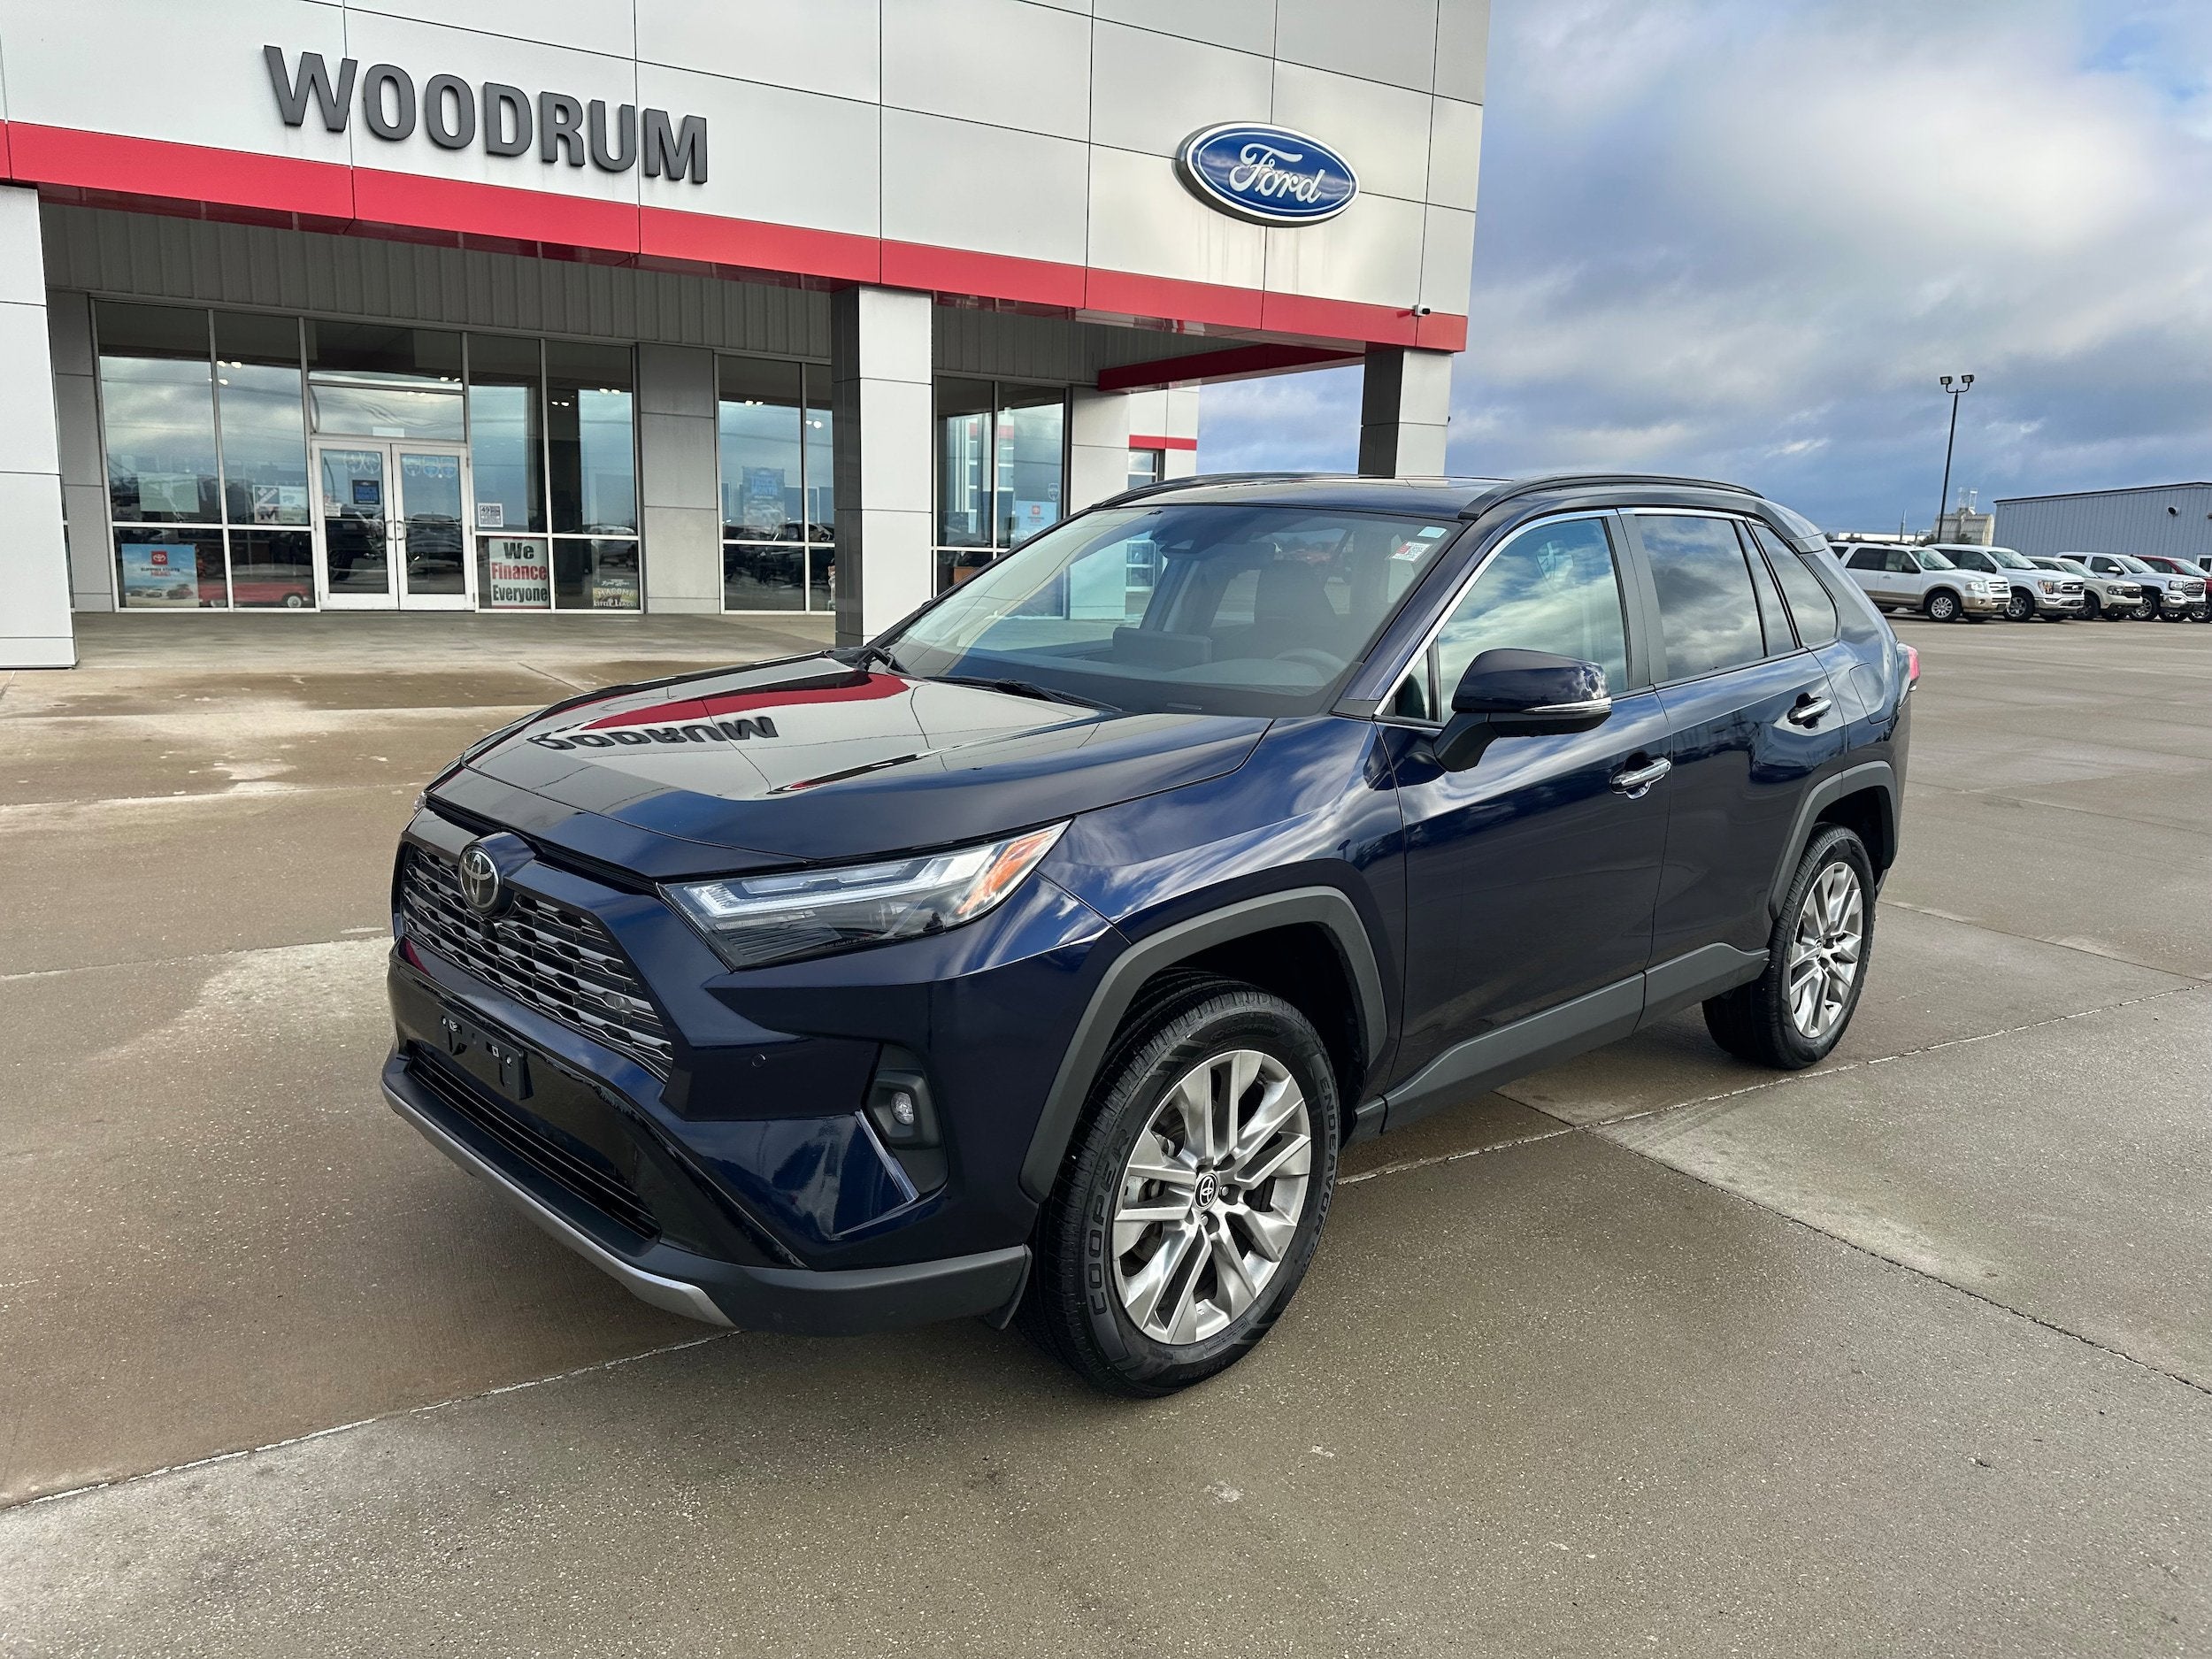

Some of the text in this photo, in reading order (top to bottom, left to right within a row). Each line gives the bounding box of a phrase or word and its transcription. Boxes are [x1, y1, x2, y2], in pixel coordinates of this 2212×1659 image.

[264, 45, 707, 184] WOODRUM
[1229, 142, 1325, 204] Ford
[491, 562, 548, 580] Finance
[503, 541, 534, 559] We
[492, 584, 549, 603] Everyone
[1315, 1077, 1336, 1235] ENDEAVOR
[1088, 1129, 1131, 1316] COOPER
